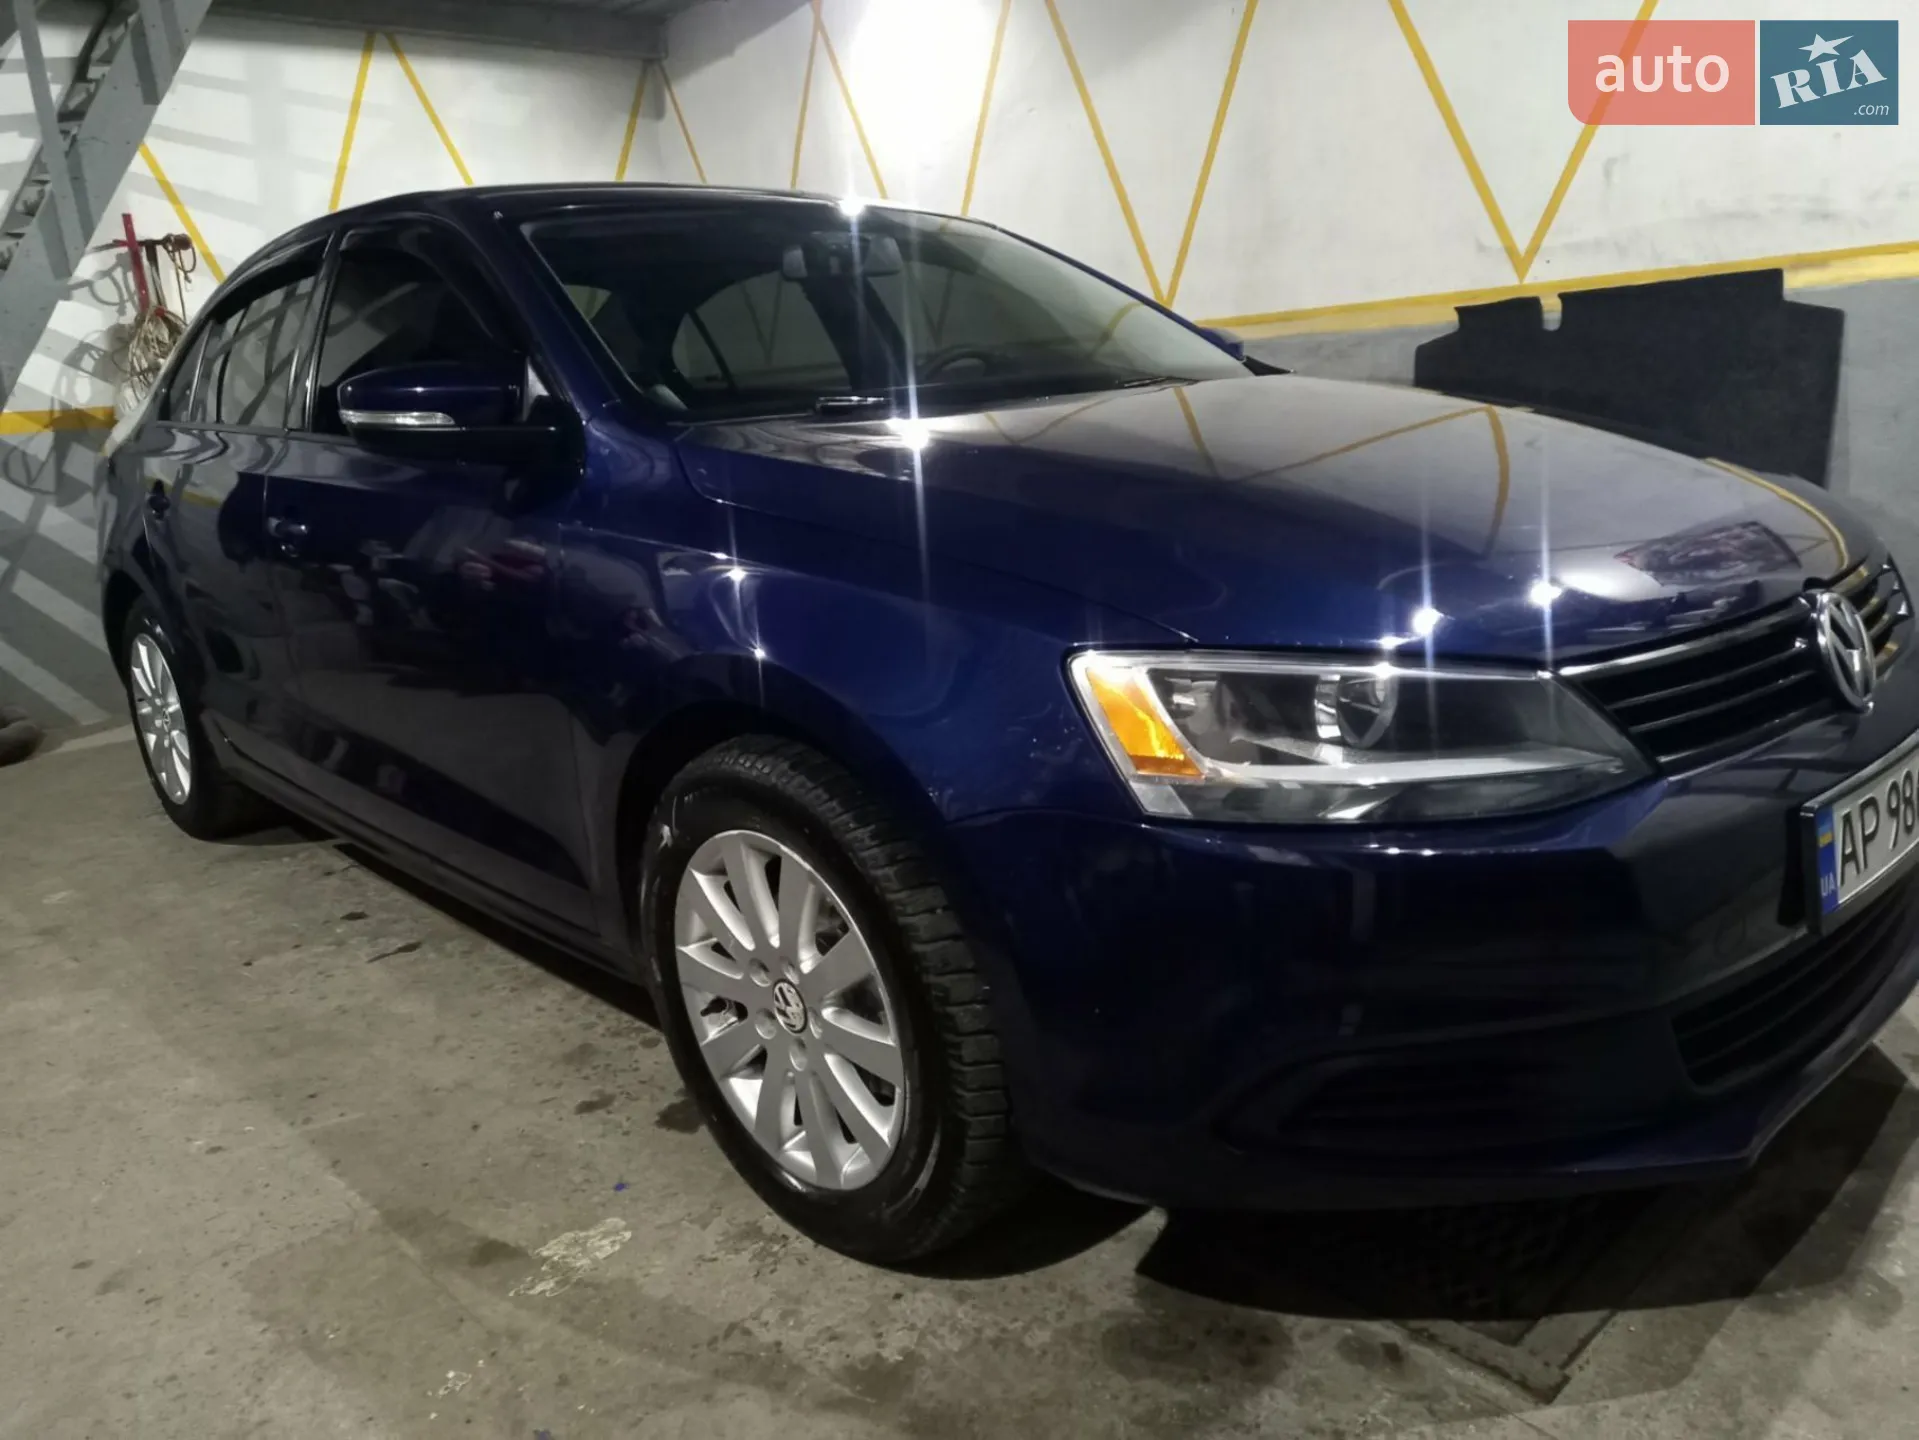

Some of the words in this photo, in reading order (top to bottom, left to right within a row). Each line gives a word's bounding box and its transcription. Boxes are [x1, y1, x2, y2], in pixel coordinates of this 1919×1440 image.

[1840, 793, 1880, 887] AP
[1887, 767, 1919, 850] 98
[1820, 871, 1837, 897] UA
